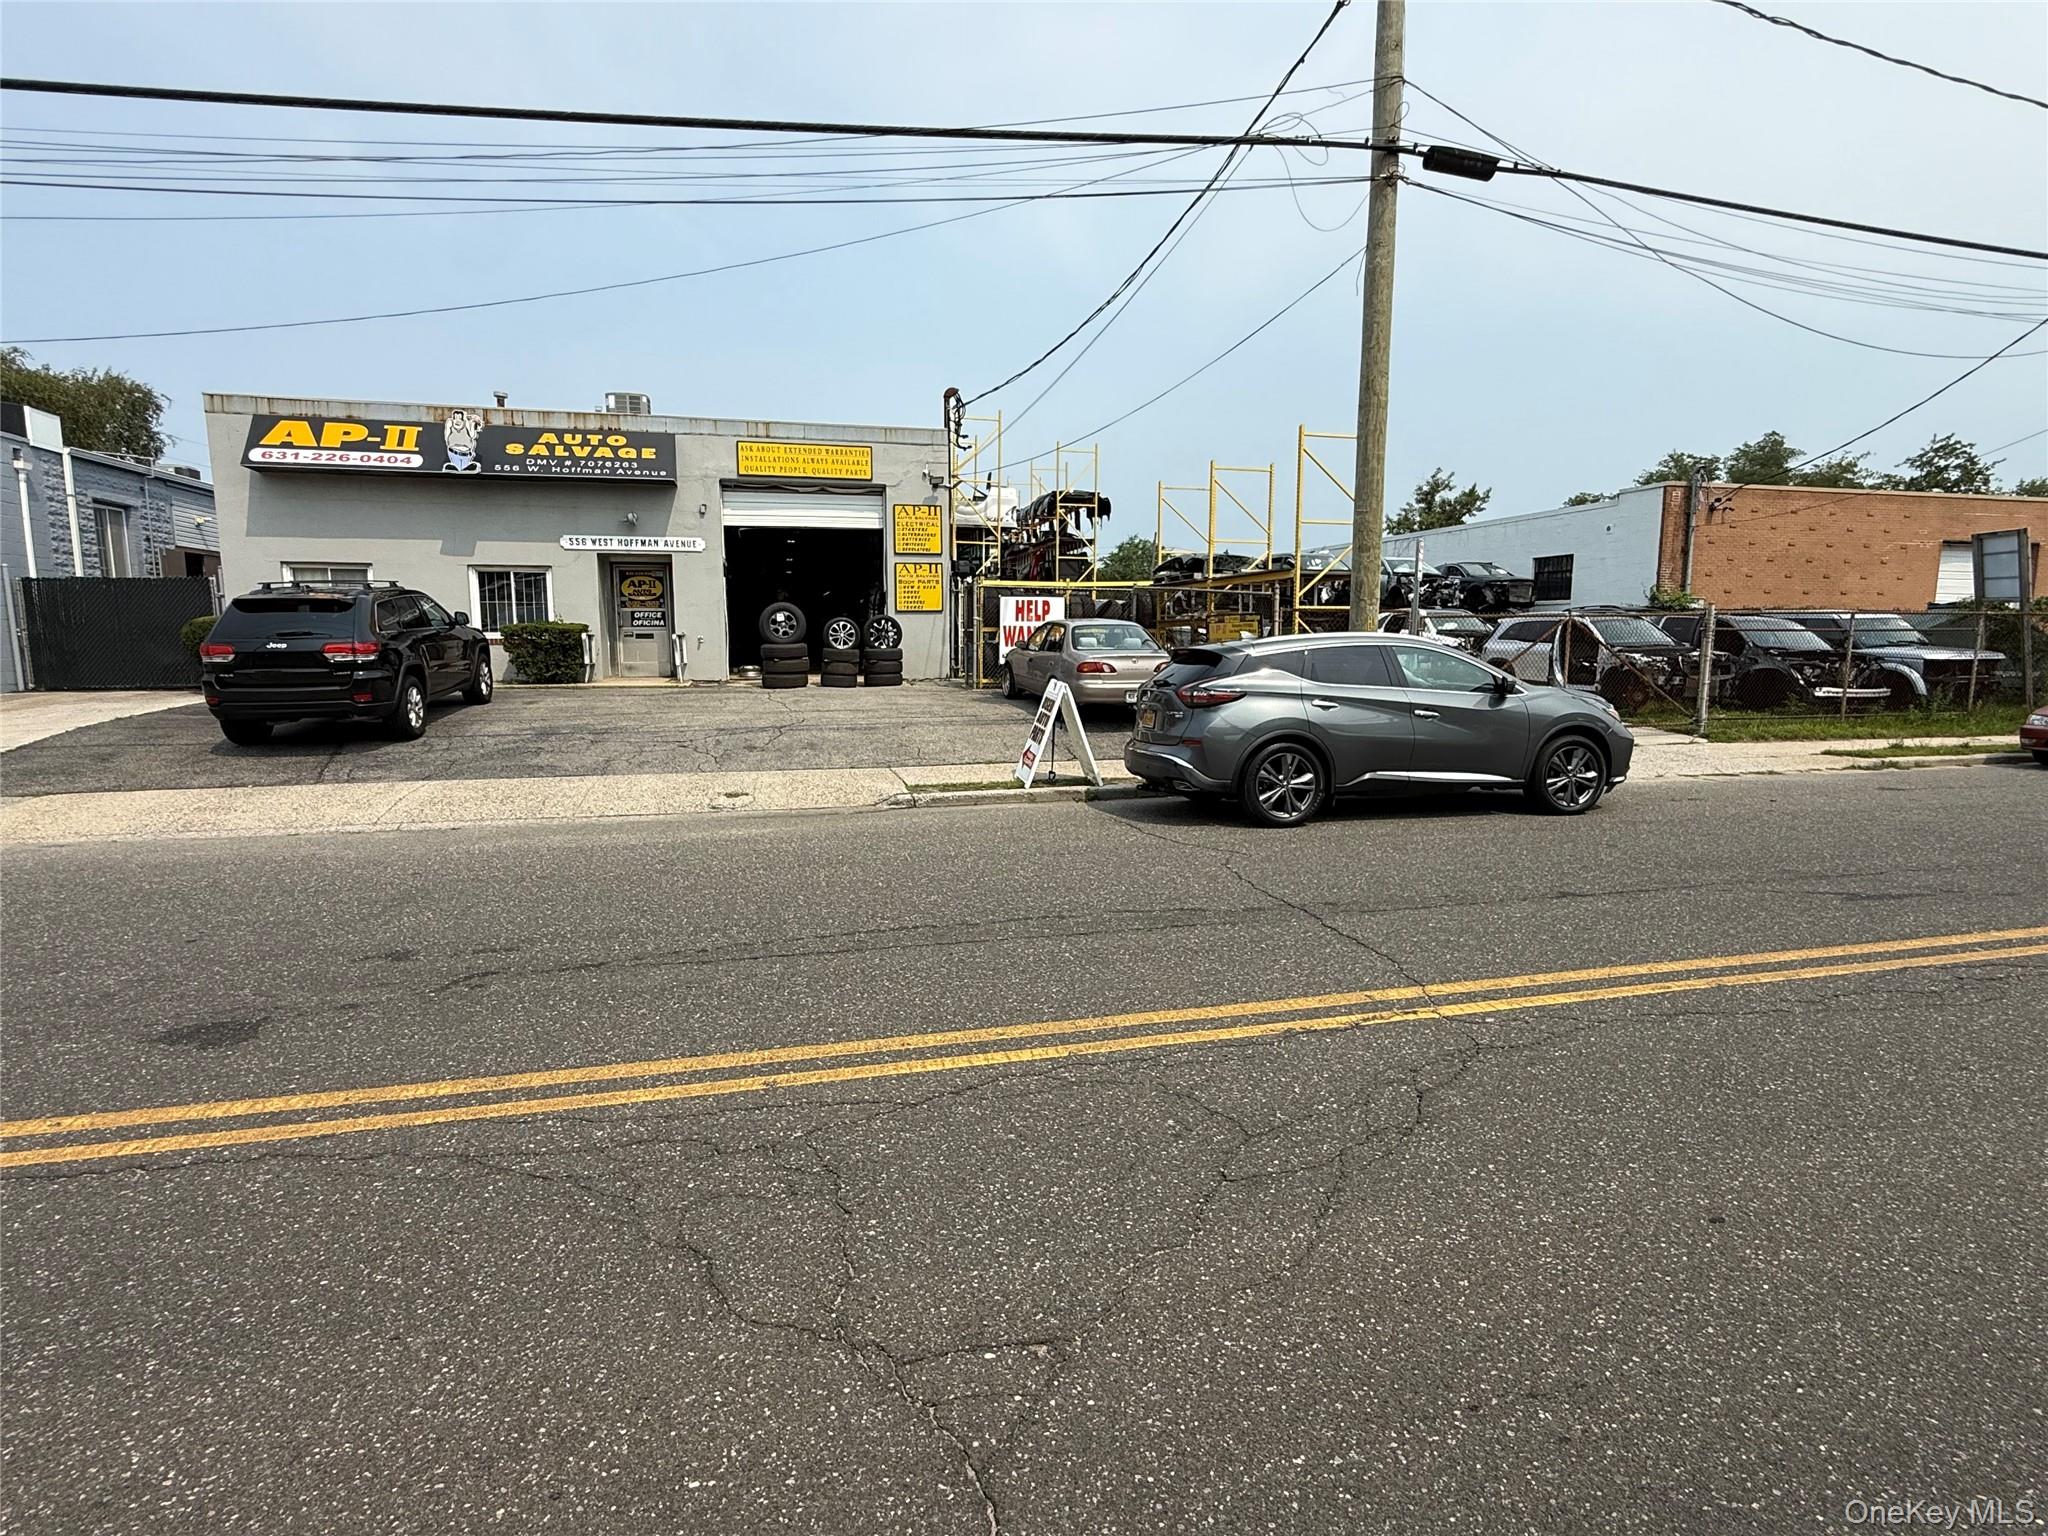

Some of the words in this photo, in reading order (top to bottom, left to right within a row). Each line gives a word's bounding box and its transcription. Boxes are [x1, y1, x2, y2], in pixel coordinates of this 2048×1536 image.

[258, 420, 423, 451] AP-II
[537, 432, 627, 446] AUTO
[504, 442, 657, 460] SALVAGE
[756, 445, 780, 453] ABOUT
[784, 447, 822, 455] EXTENDED
[825, 448, 870, 457] WARRANTIES
[260, 451, 413, 465] 631-226-0404
[526, 458, 558, 466] DMV
[579, 460, 638, 468] 7076263
[741, 455, 799, 464] INSTALLATIONS
[802, 457, 828, 465] ALWAYS
[831, 458, 869, 466] AVAILABLE
[494, 464, 520, 472] 556
[527, 465, 544, 473] W.
[552, 467, 610, 475] Hoffman
[616, 469, 668, 477] Avenue
[744, 465, 776, 473] QUALITY
[811, 467, 842, 476] QUALITY
[845, 468, 867, 476] PARTS
[897, 505, 938, 516] AP-II
[568, 537, 587, 546] 556
[590, 537, 613, 547] WEST
[617, 538, 659, 547] HOFFMAN
[663, 539, 697, 549] AVENUE
[899, 564, 939, 574] AP-II
[633, 611, 663, 619] OFFICE
[1015, 600, 1051, 622] HELP
[266, 641, 288, 649] Jeep
